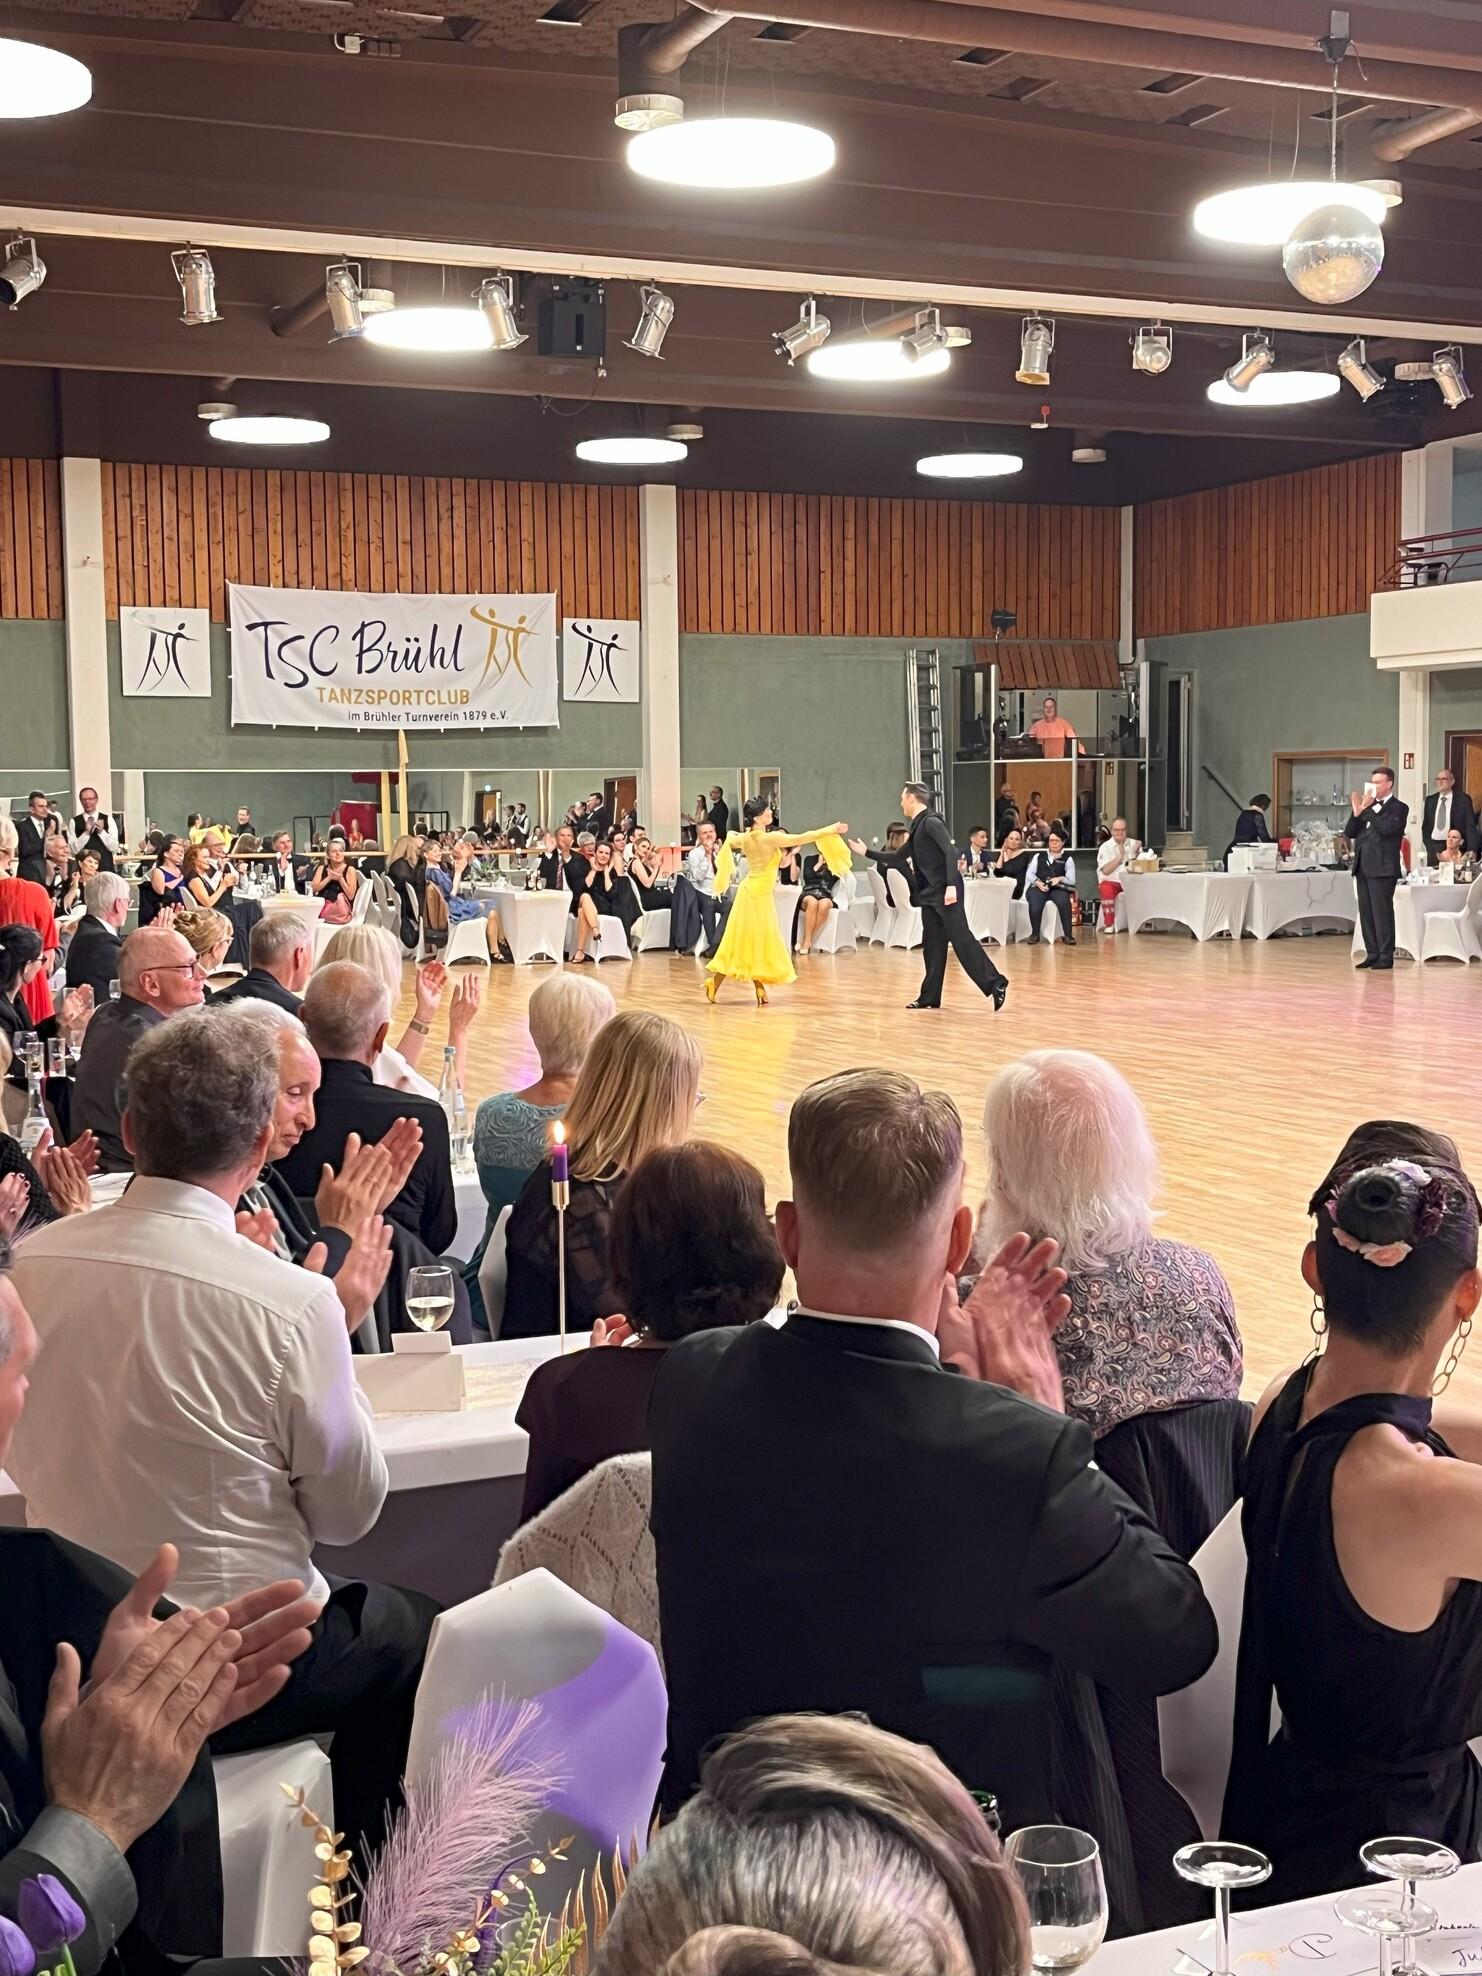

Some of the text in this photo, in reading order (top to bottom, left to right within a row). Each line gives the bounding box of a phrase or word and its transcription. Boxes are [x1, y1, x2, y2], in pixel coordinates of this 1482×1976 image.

[245, 620, 465, 688] TSC Brühl
[315, 686, 470, 706] TANZSPORTCLUB
[363, 711, 401, 722] Brühler
[404, 711, 459, 722] Turnverein
[462, 710, 487, 721] 1879
[490, 709, 510, 721] e.V.
